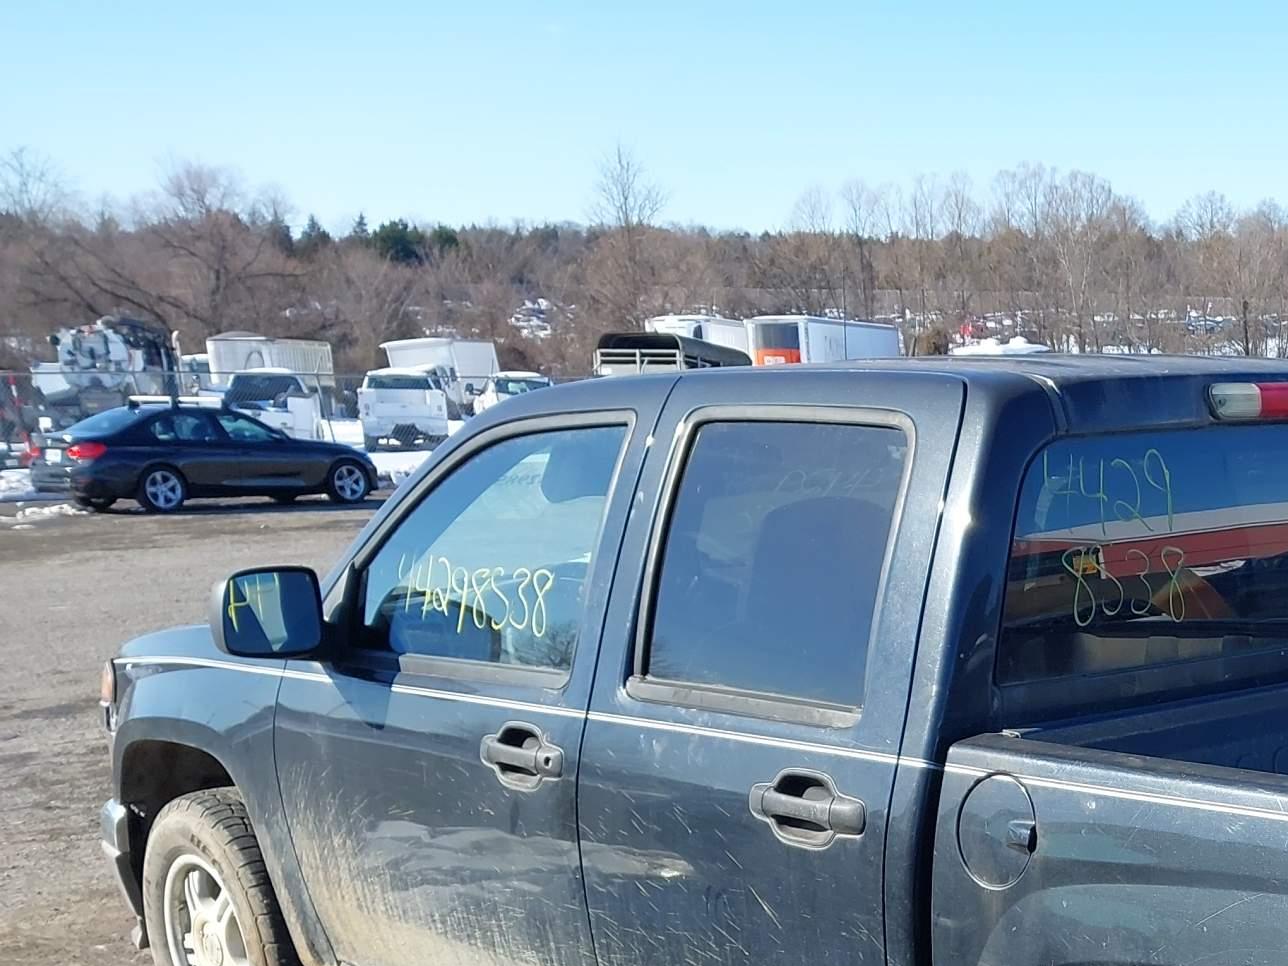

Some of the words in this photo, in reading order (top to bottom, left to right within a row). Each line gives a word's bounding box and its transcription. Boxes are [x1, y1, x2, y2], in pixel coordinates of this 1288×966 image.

[1043, 448, 1174, 537] 4429
[398, 553, 555, 637] 44298538
[1061, 544, 1185, 627] 8538
